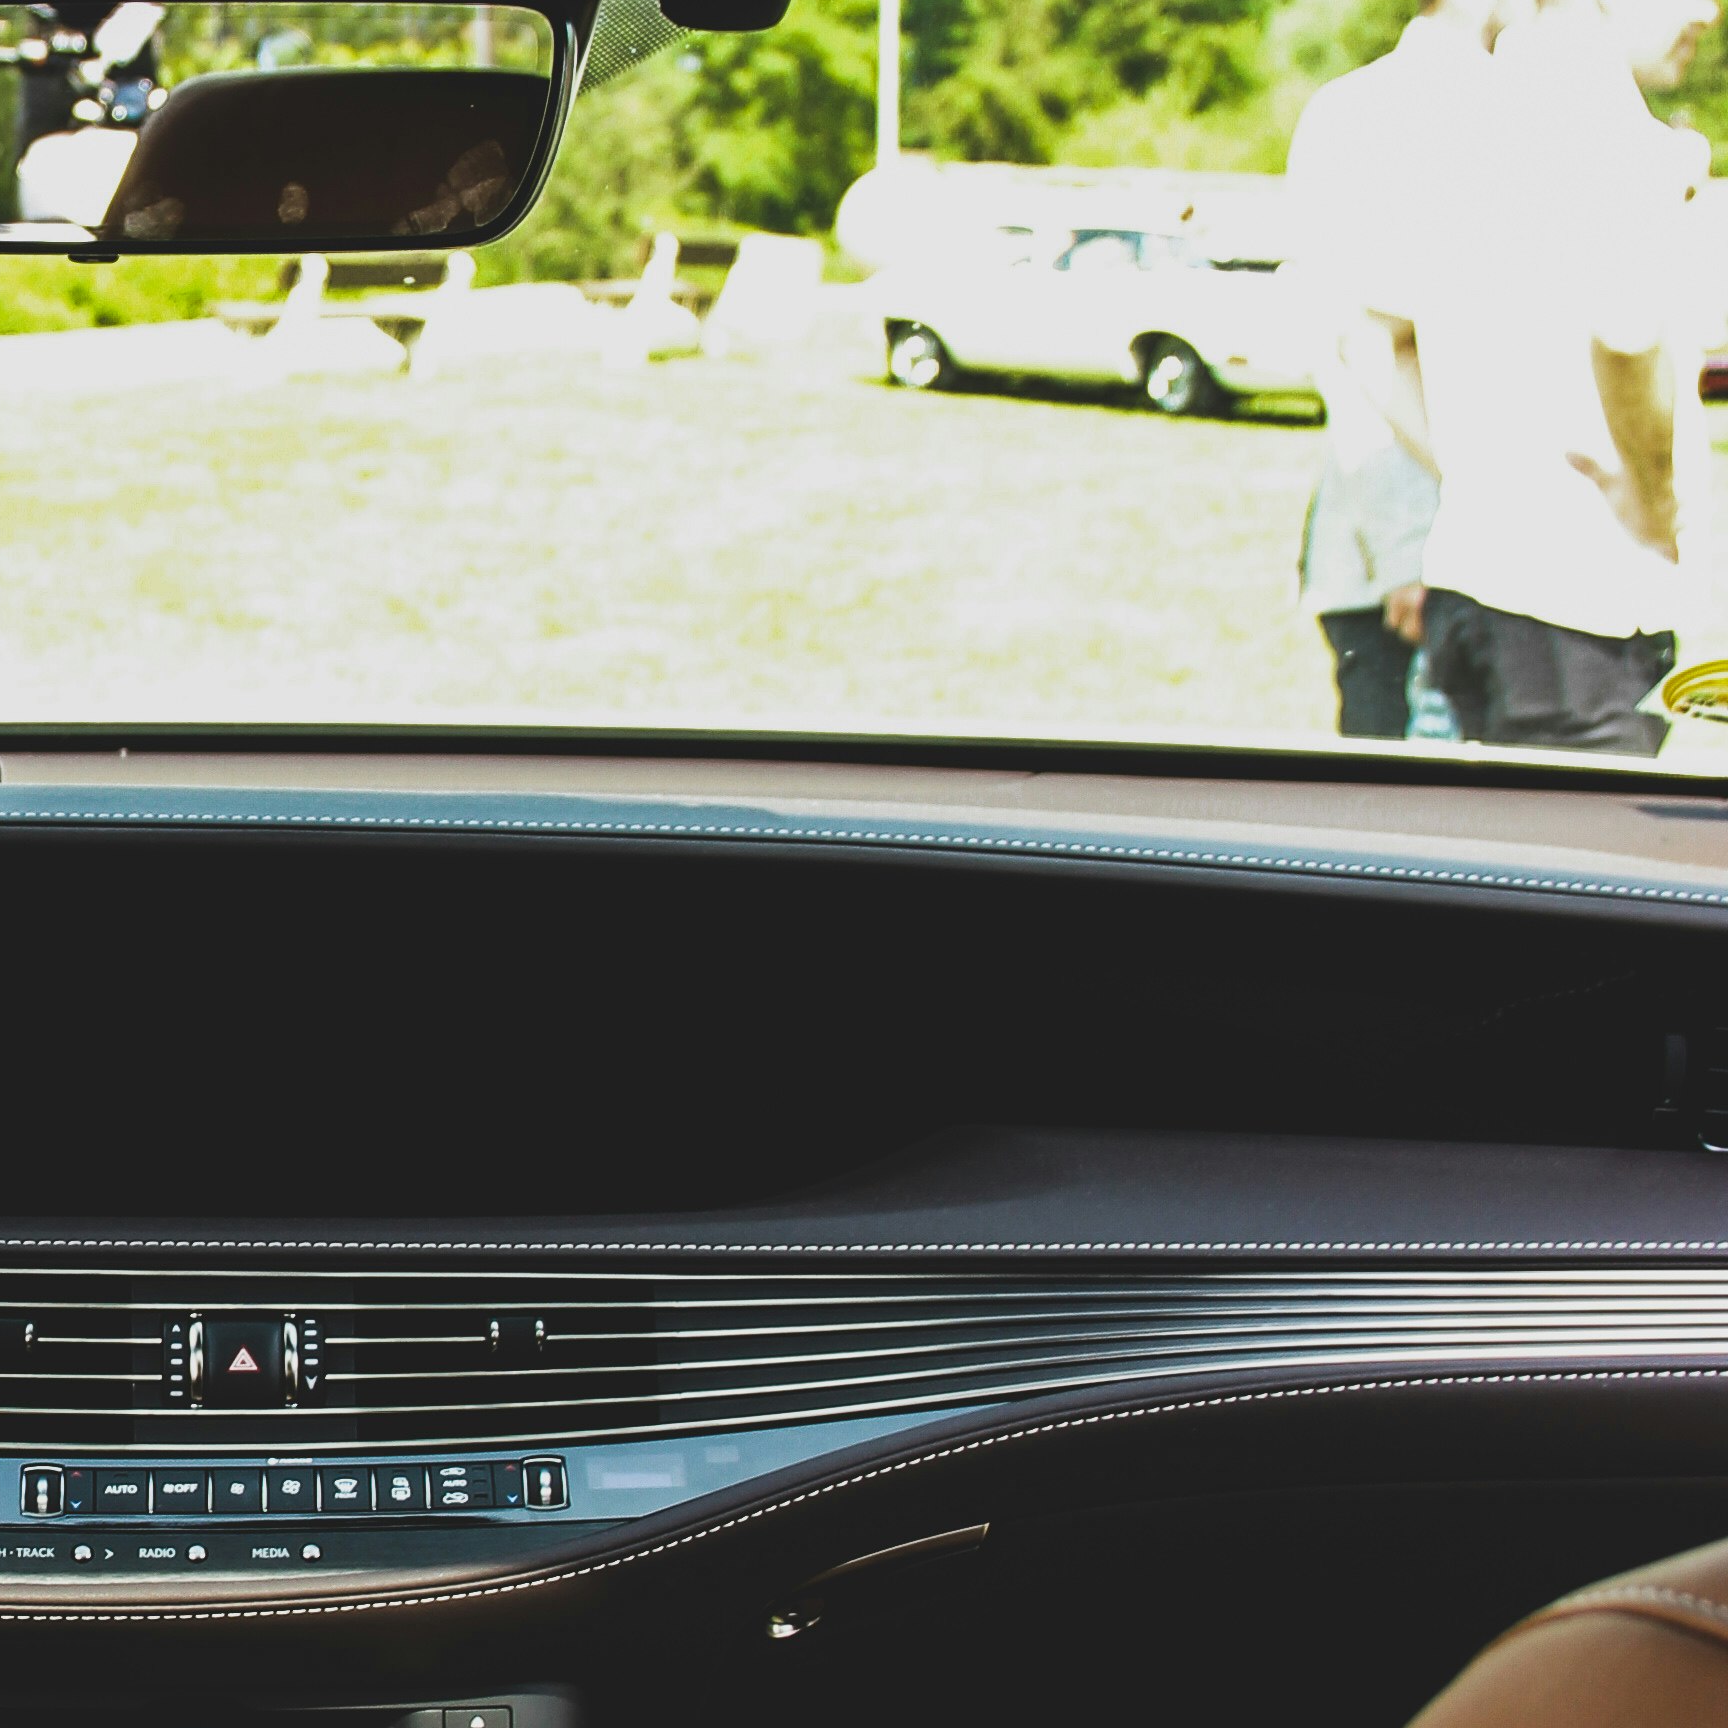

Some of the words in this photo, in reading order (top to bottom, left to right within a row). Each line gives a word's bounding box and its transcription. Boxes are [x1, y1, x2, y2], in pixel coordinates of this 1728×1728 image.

[104, 1484, 138, 1495] AUTO
[174, 1483, 198, 1493] OFF
[138, 1547, 176, 1558] RADIO
[251, 1547, 290, 1558] MEDIA
